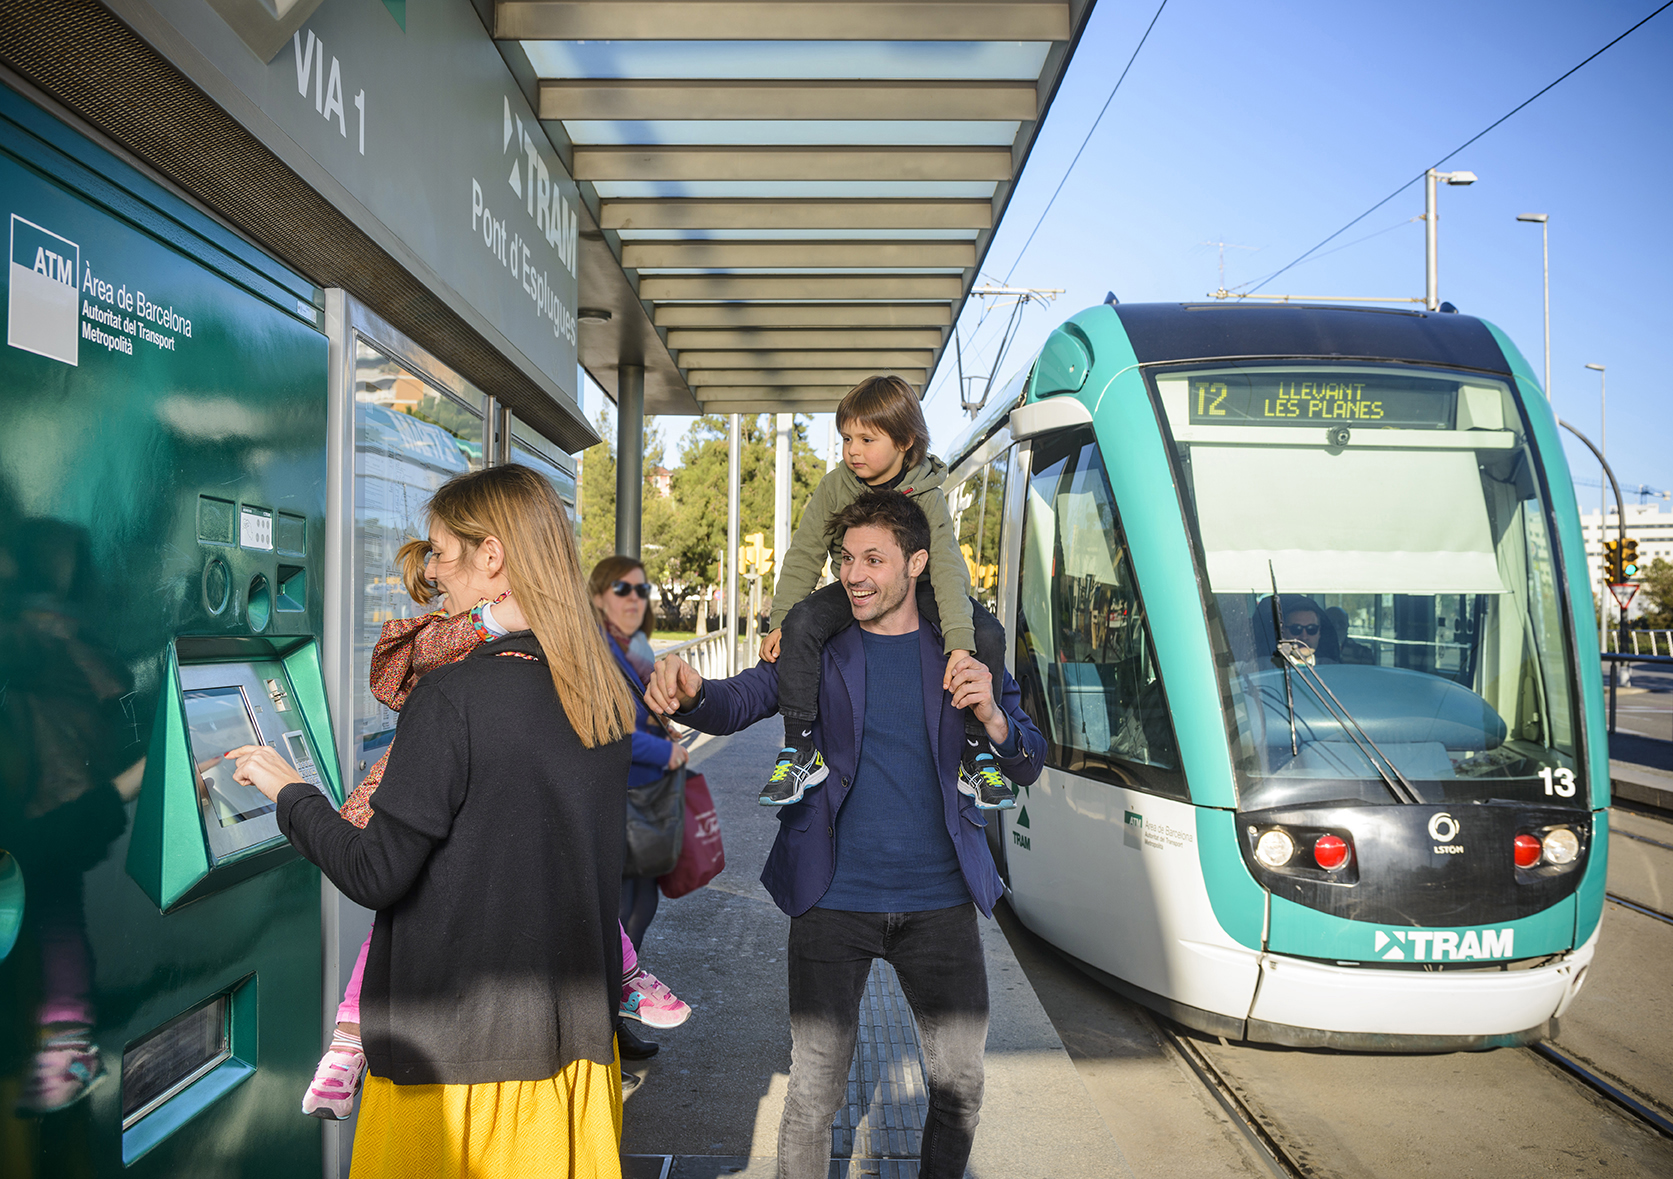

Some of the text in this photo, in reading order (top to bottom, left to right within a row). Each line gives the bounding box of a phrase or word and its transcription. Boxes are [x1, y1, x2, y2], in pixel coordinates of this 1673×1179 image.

[293, 28, 365, 156] VIA 1
[523, 129, 577, 280] TRAM
[472, 177, 507, 267] Pont
[33, 246, 73, 287] ATM
[82, 260, 192, 338] Àrea de Barcelona
[82, 300, 175, 351] Autoritat del Transport
[82, 321, 133, 355] Metropolità
[1195, 382, 1228, 416] T2
[1279, 382, 1366, 400] LLEVANT
[1264, 399, 1384, 419] LES PLANES
[1538, 766, 1576, 798] 13
[1129, 816, 1142, 828] ATM
[1158, 824, 1165, 834] de
[1165, 825, 1193, 843] Barcelona
[1012, 830, 1031, 851] TRAM
[1407, 928, 1514, 960] TRAM
